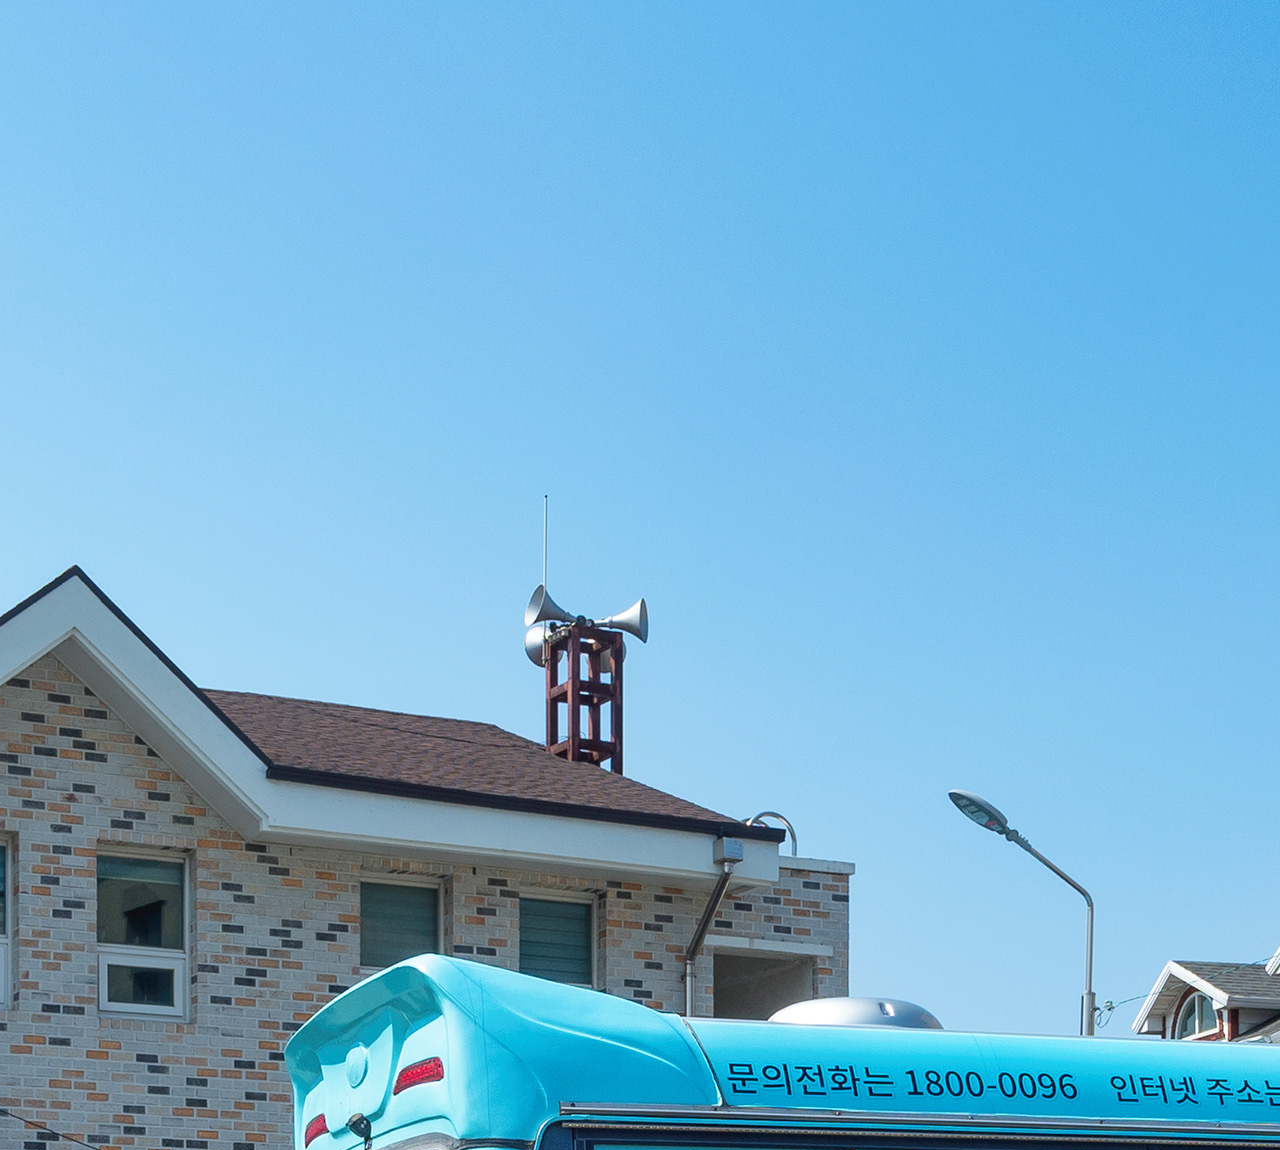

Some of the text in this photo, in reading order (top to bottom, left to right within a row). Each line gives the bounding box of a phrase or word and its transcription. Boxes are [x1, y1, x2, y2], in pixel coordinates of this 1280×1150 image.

[726, 1062, 1079, 1100] 문의전화는 1800-0096
[1109, 1074, 1199, 1106] 인터넷
